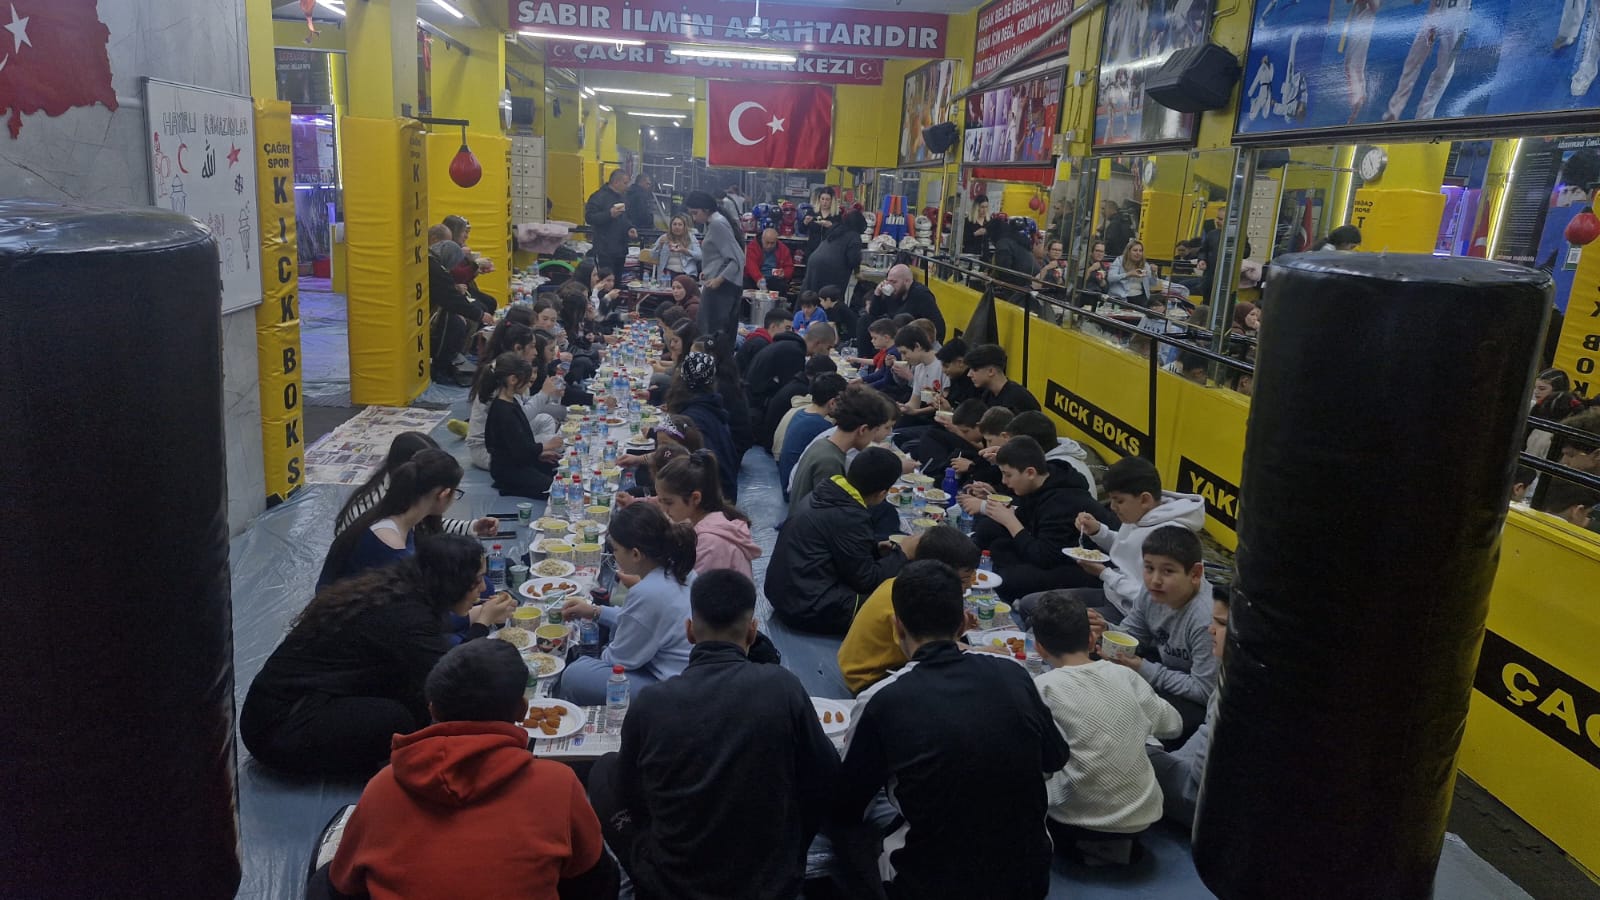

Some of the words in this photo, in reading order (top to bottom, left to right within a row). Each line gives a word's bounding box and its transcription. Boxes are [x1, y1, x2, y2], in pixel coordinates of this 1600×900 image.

[518, 1, 610, 29] SABIR
[622, 1, 714, 36] İLMİN
[263, 142, 291, 155] ÇAĞRI
[267, 158, 290, 169] SPOR
[273, 176, 296, 323] KICK
[412, 163, 422, 265] KICK
[415, 282, 425, 378] BOKS
[282, 346, 301, 485] BOKS
[1054, 391, 1091, 425] KICK
[1092, 414, 1141, 456] BOKS
